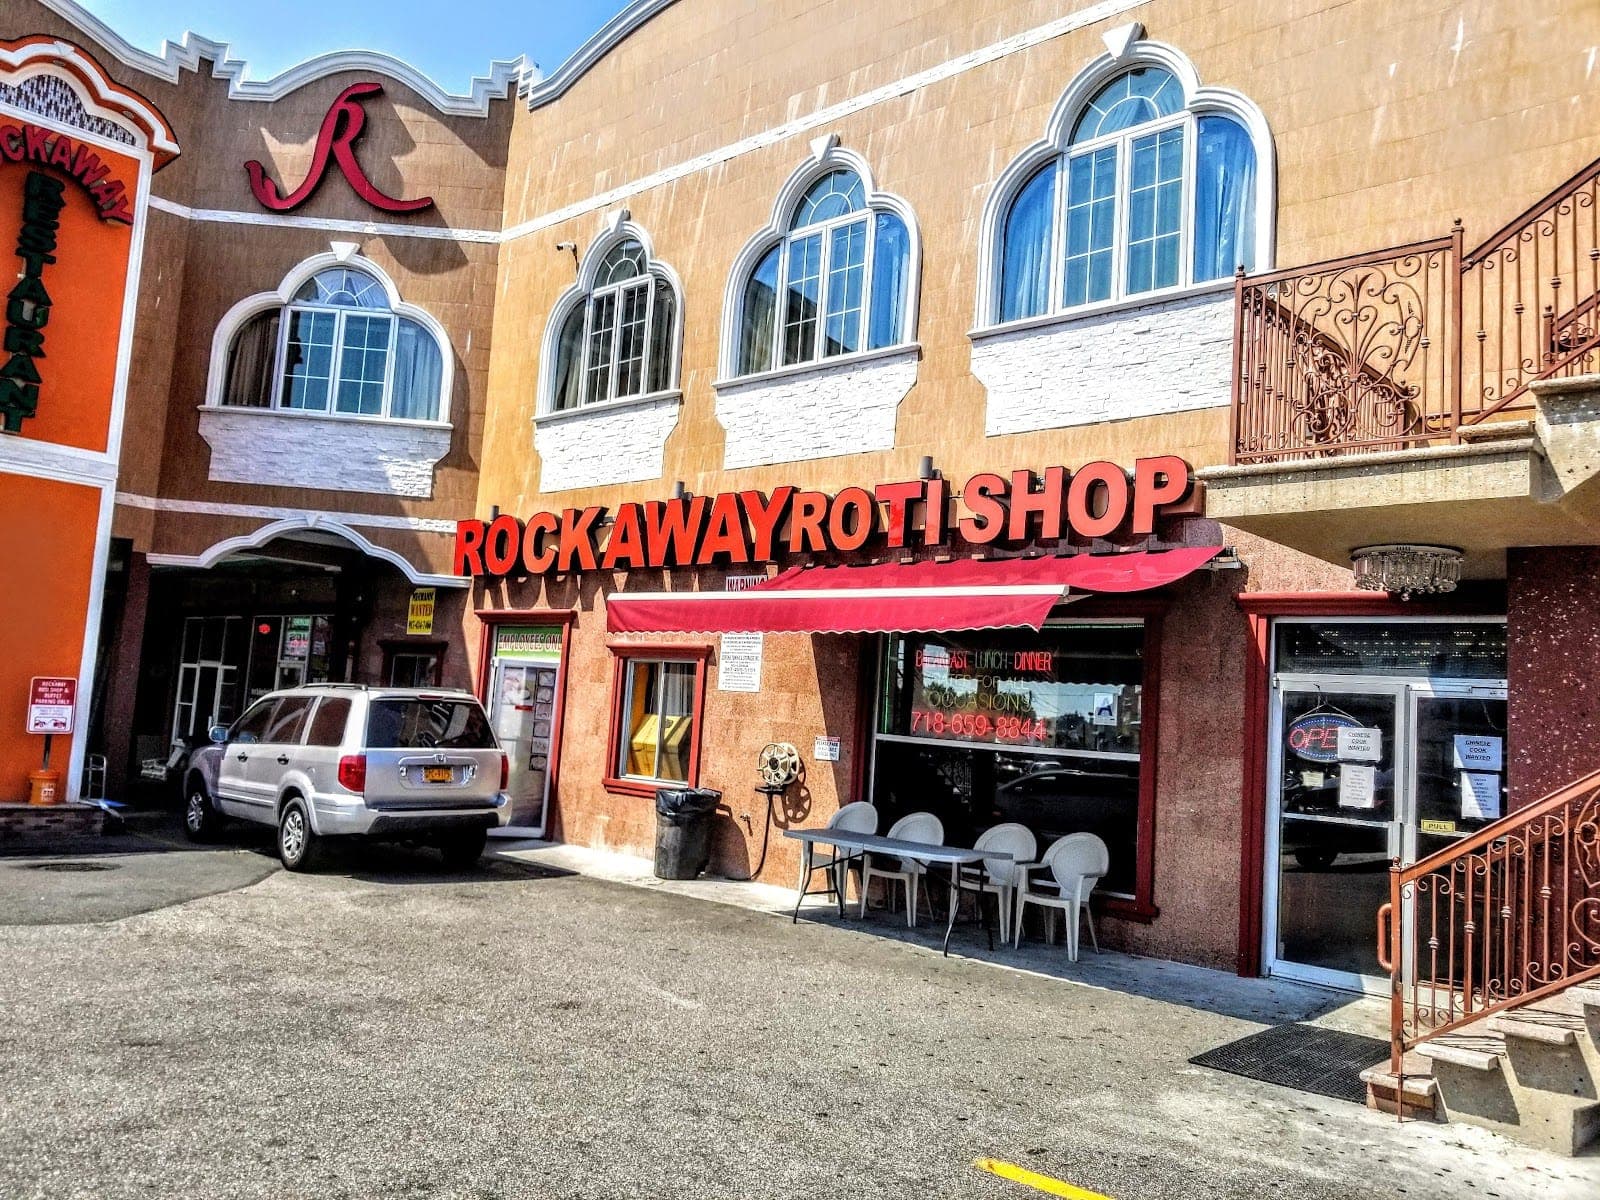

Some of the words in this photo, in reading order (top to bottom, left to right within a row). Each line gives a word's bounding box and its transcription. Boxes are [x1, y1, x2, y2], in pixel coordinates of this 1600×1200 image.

[0, 124, 134, 226] CKAWAY
[454, 486, 797, 577] ROCKAWAY
[789, 479, 946, 553] ROTI
[959, 454, 1192, 545] SHOP
[498, 633, 544, 651] EMPLOYEES
[545, 633, 562, 652] ONL
[975, 650, 1008, 670] LUNCH
[1014, 651, 1052, 671] DINNER
[928, 689, 1032, 712] OCCASIONS
[911, 711, 1048, 741] 718-659-8844
[1289, 727, 1340, 749] OPE
